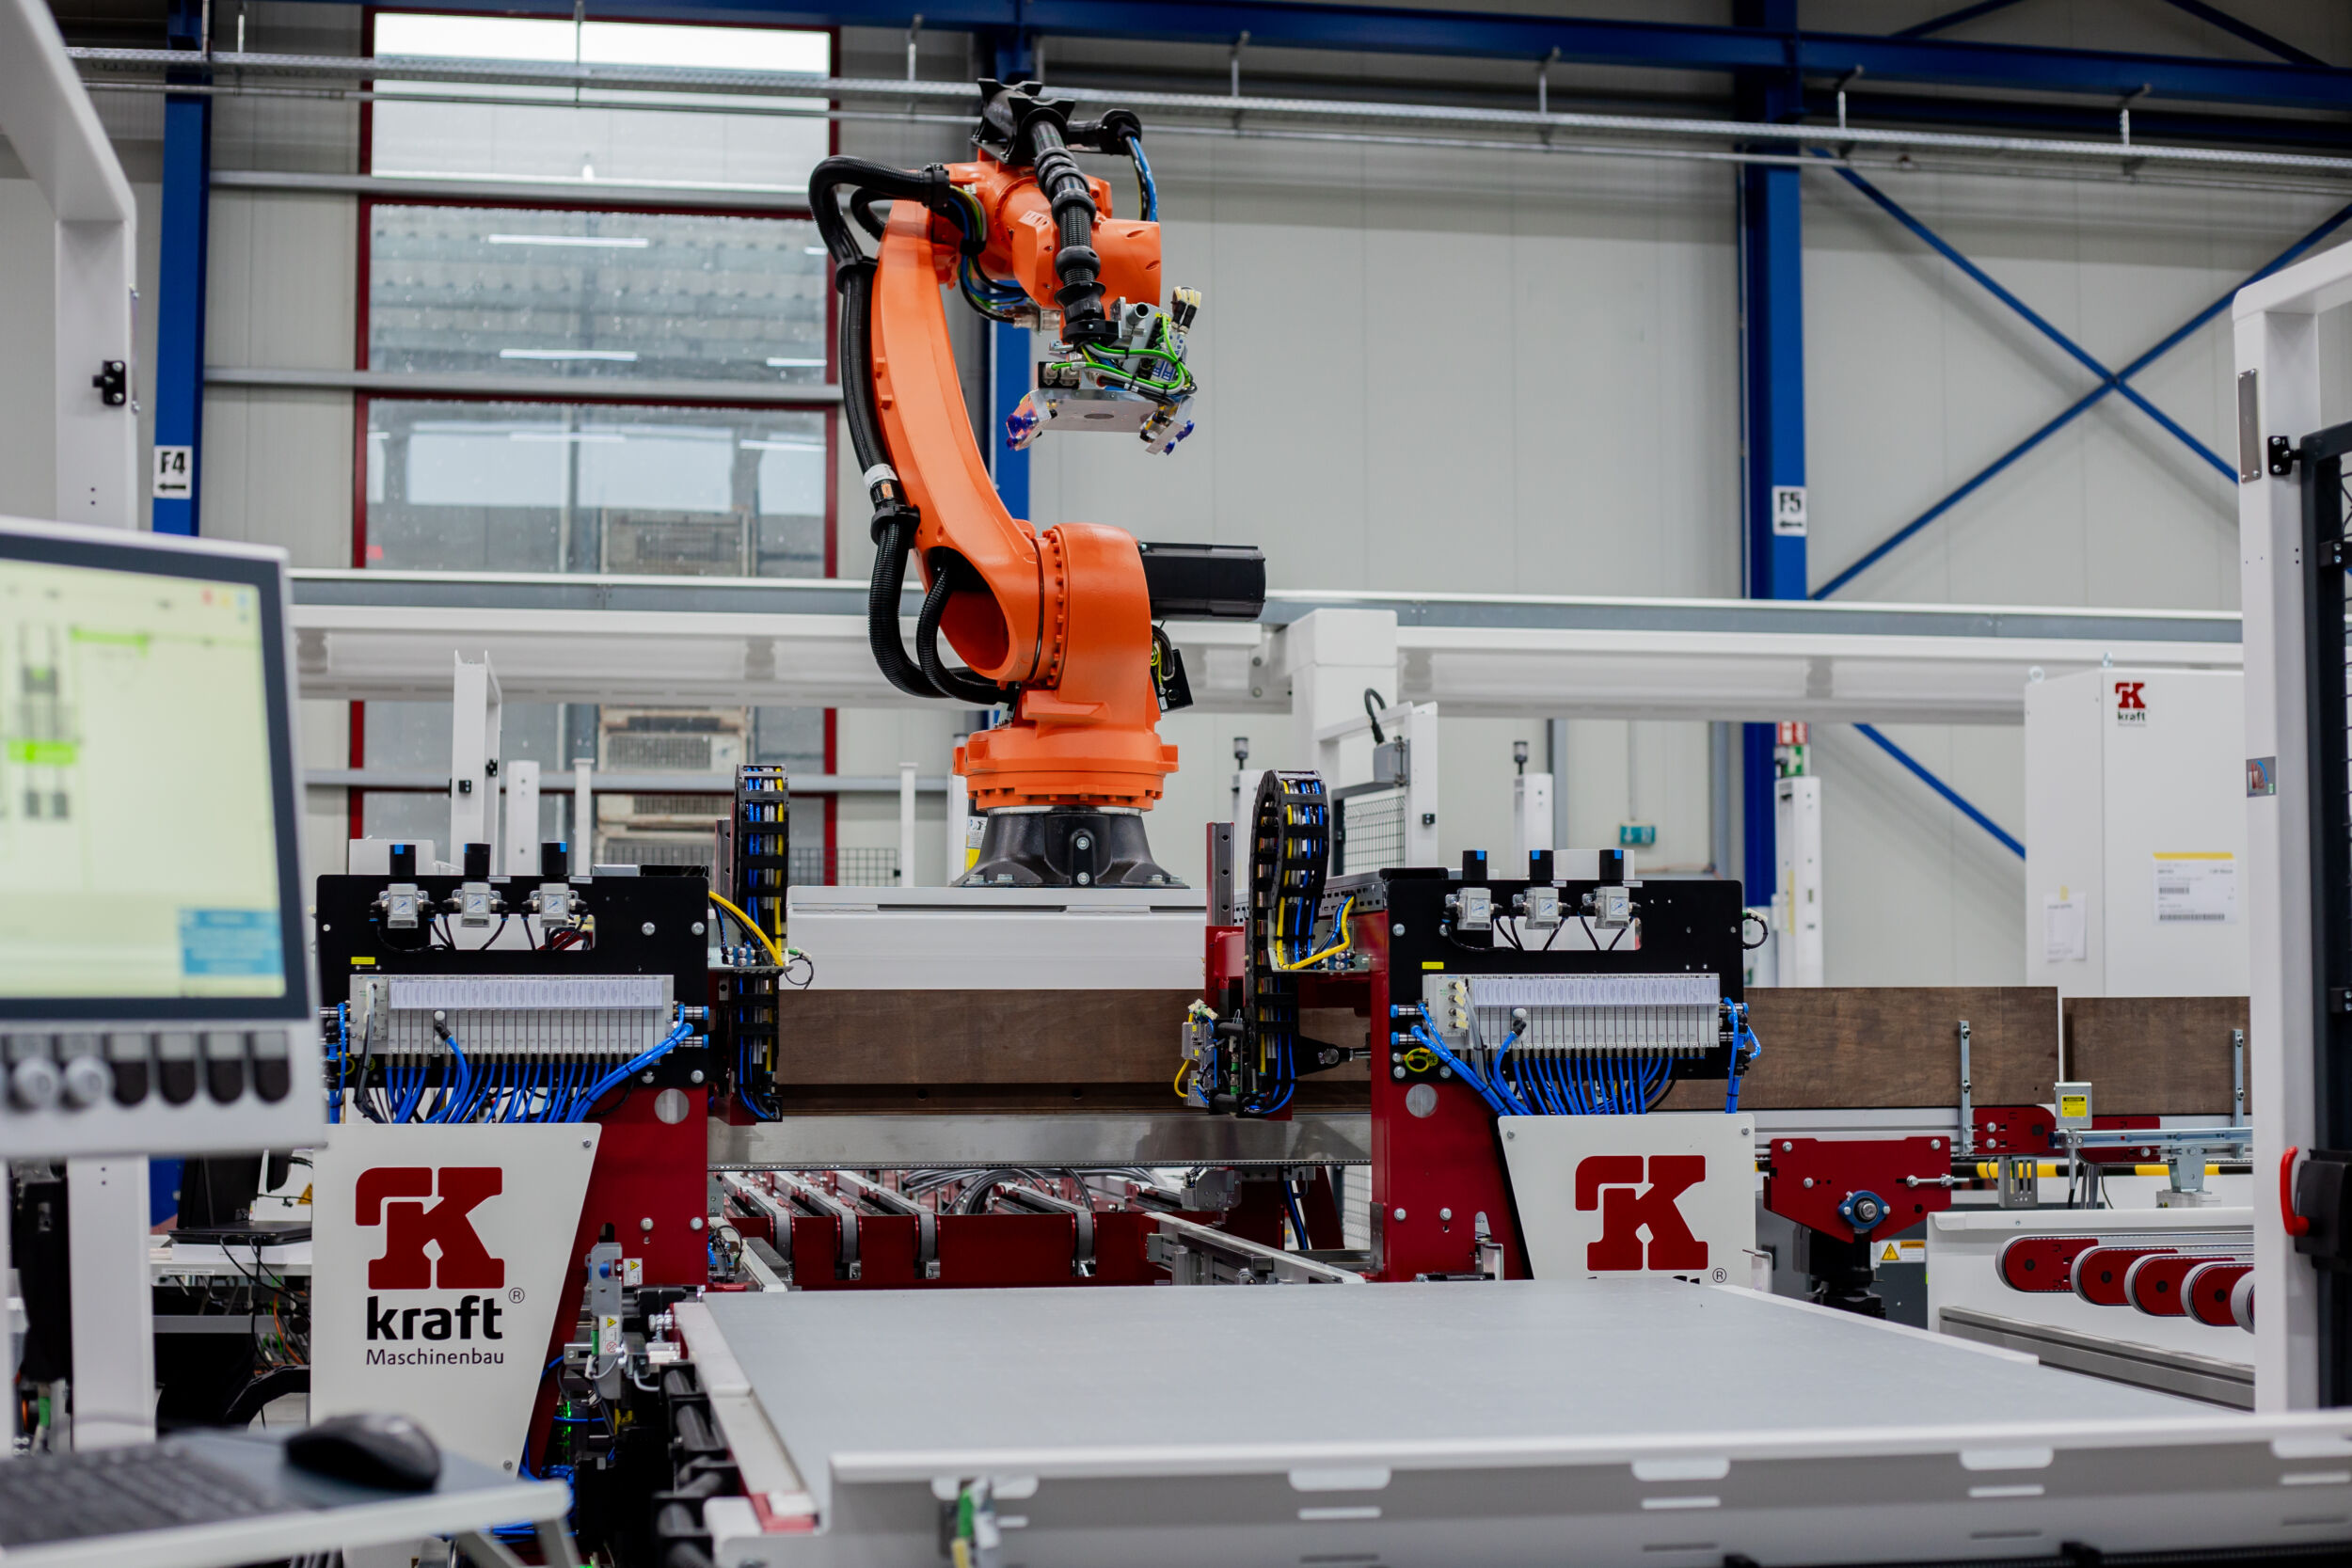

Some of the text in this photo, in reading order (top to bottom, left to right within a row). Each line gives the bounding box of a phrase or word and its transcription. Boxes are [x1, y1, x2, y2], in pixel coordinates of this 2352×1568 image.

[161, 451, 185, 474] F4
[1779, 492, 1801, 513] F5
[367, 1295, 503, 1340] kraft
[366, 1347, 504, 1365] Maschinenbau
